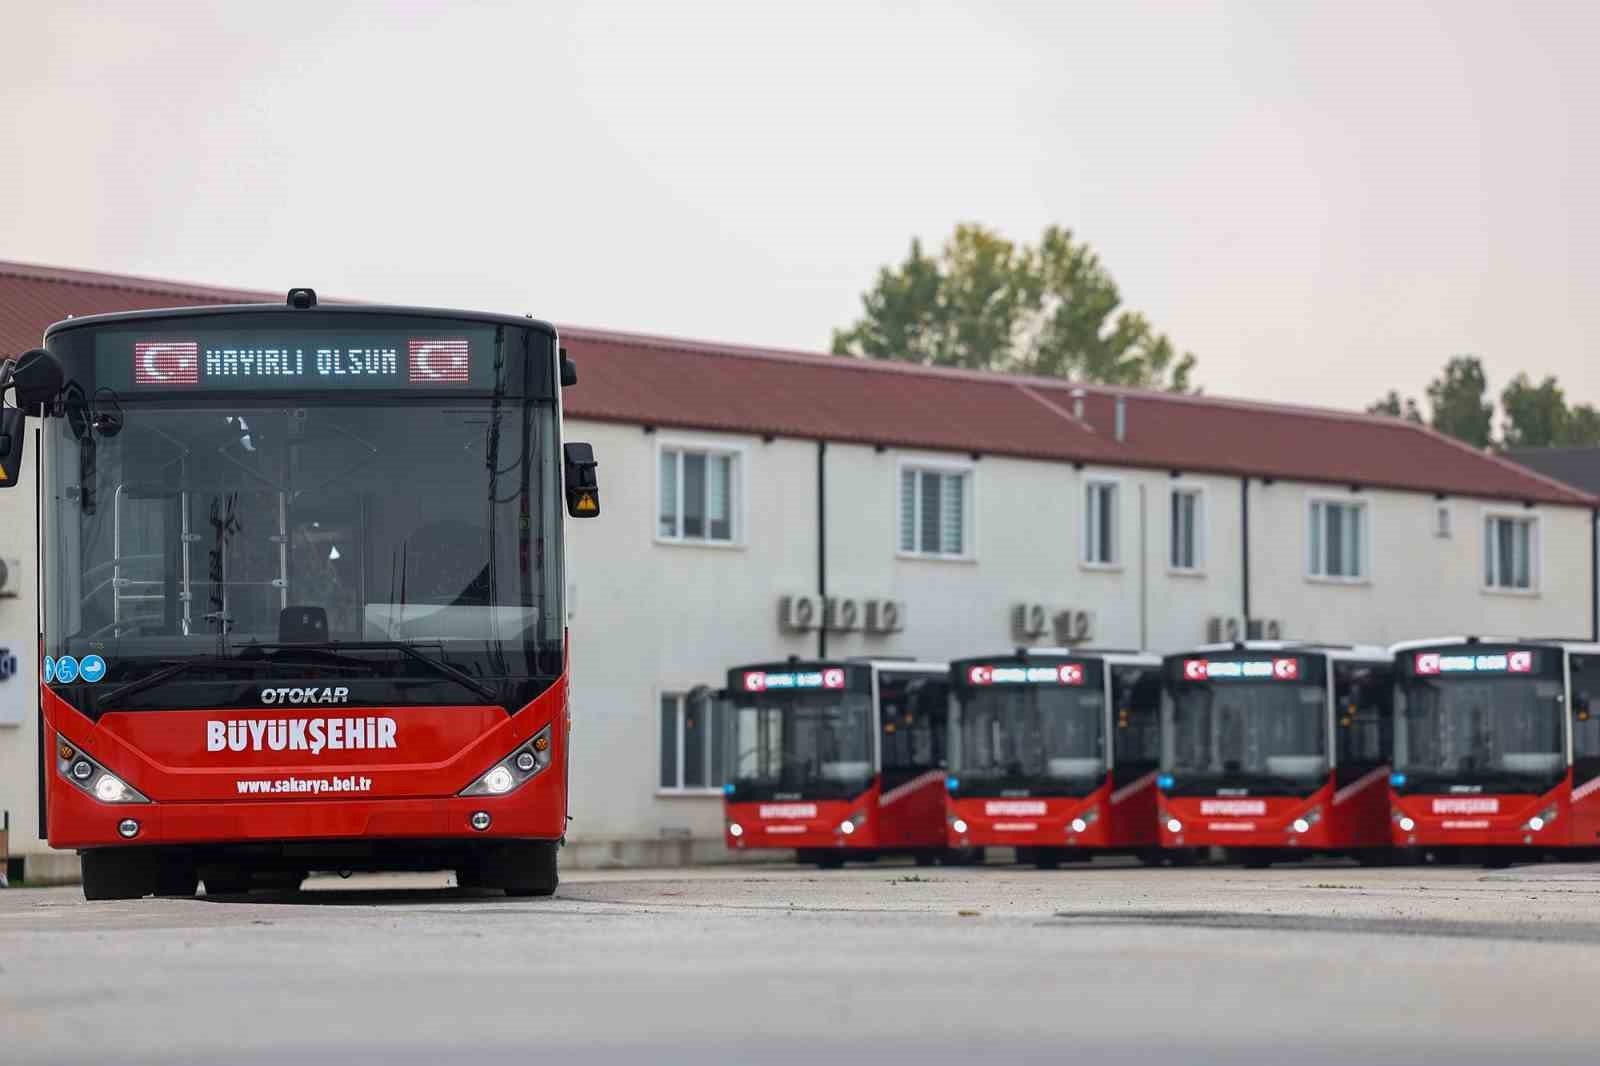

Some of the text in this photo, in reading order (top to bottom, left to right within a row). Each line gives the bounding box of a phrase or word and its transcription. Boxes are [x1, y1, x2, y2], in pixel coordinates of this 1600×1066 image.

[206, 349, 397, 375] HAYIRLI OLSUN
[260, 687, 349, 704] OTOKAR
[207, 716, 398, 754] BÜYÜKŞEHİR
[236, 776, 372, 794] www.sakarya.bel.tr
